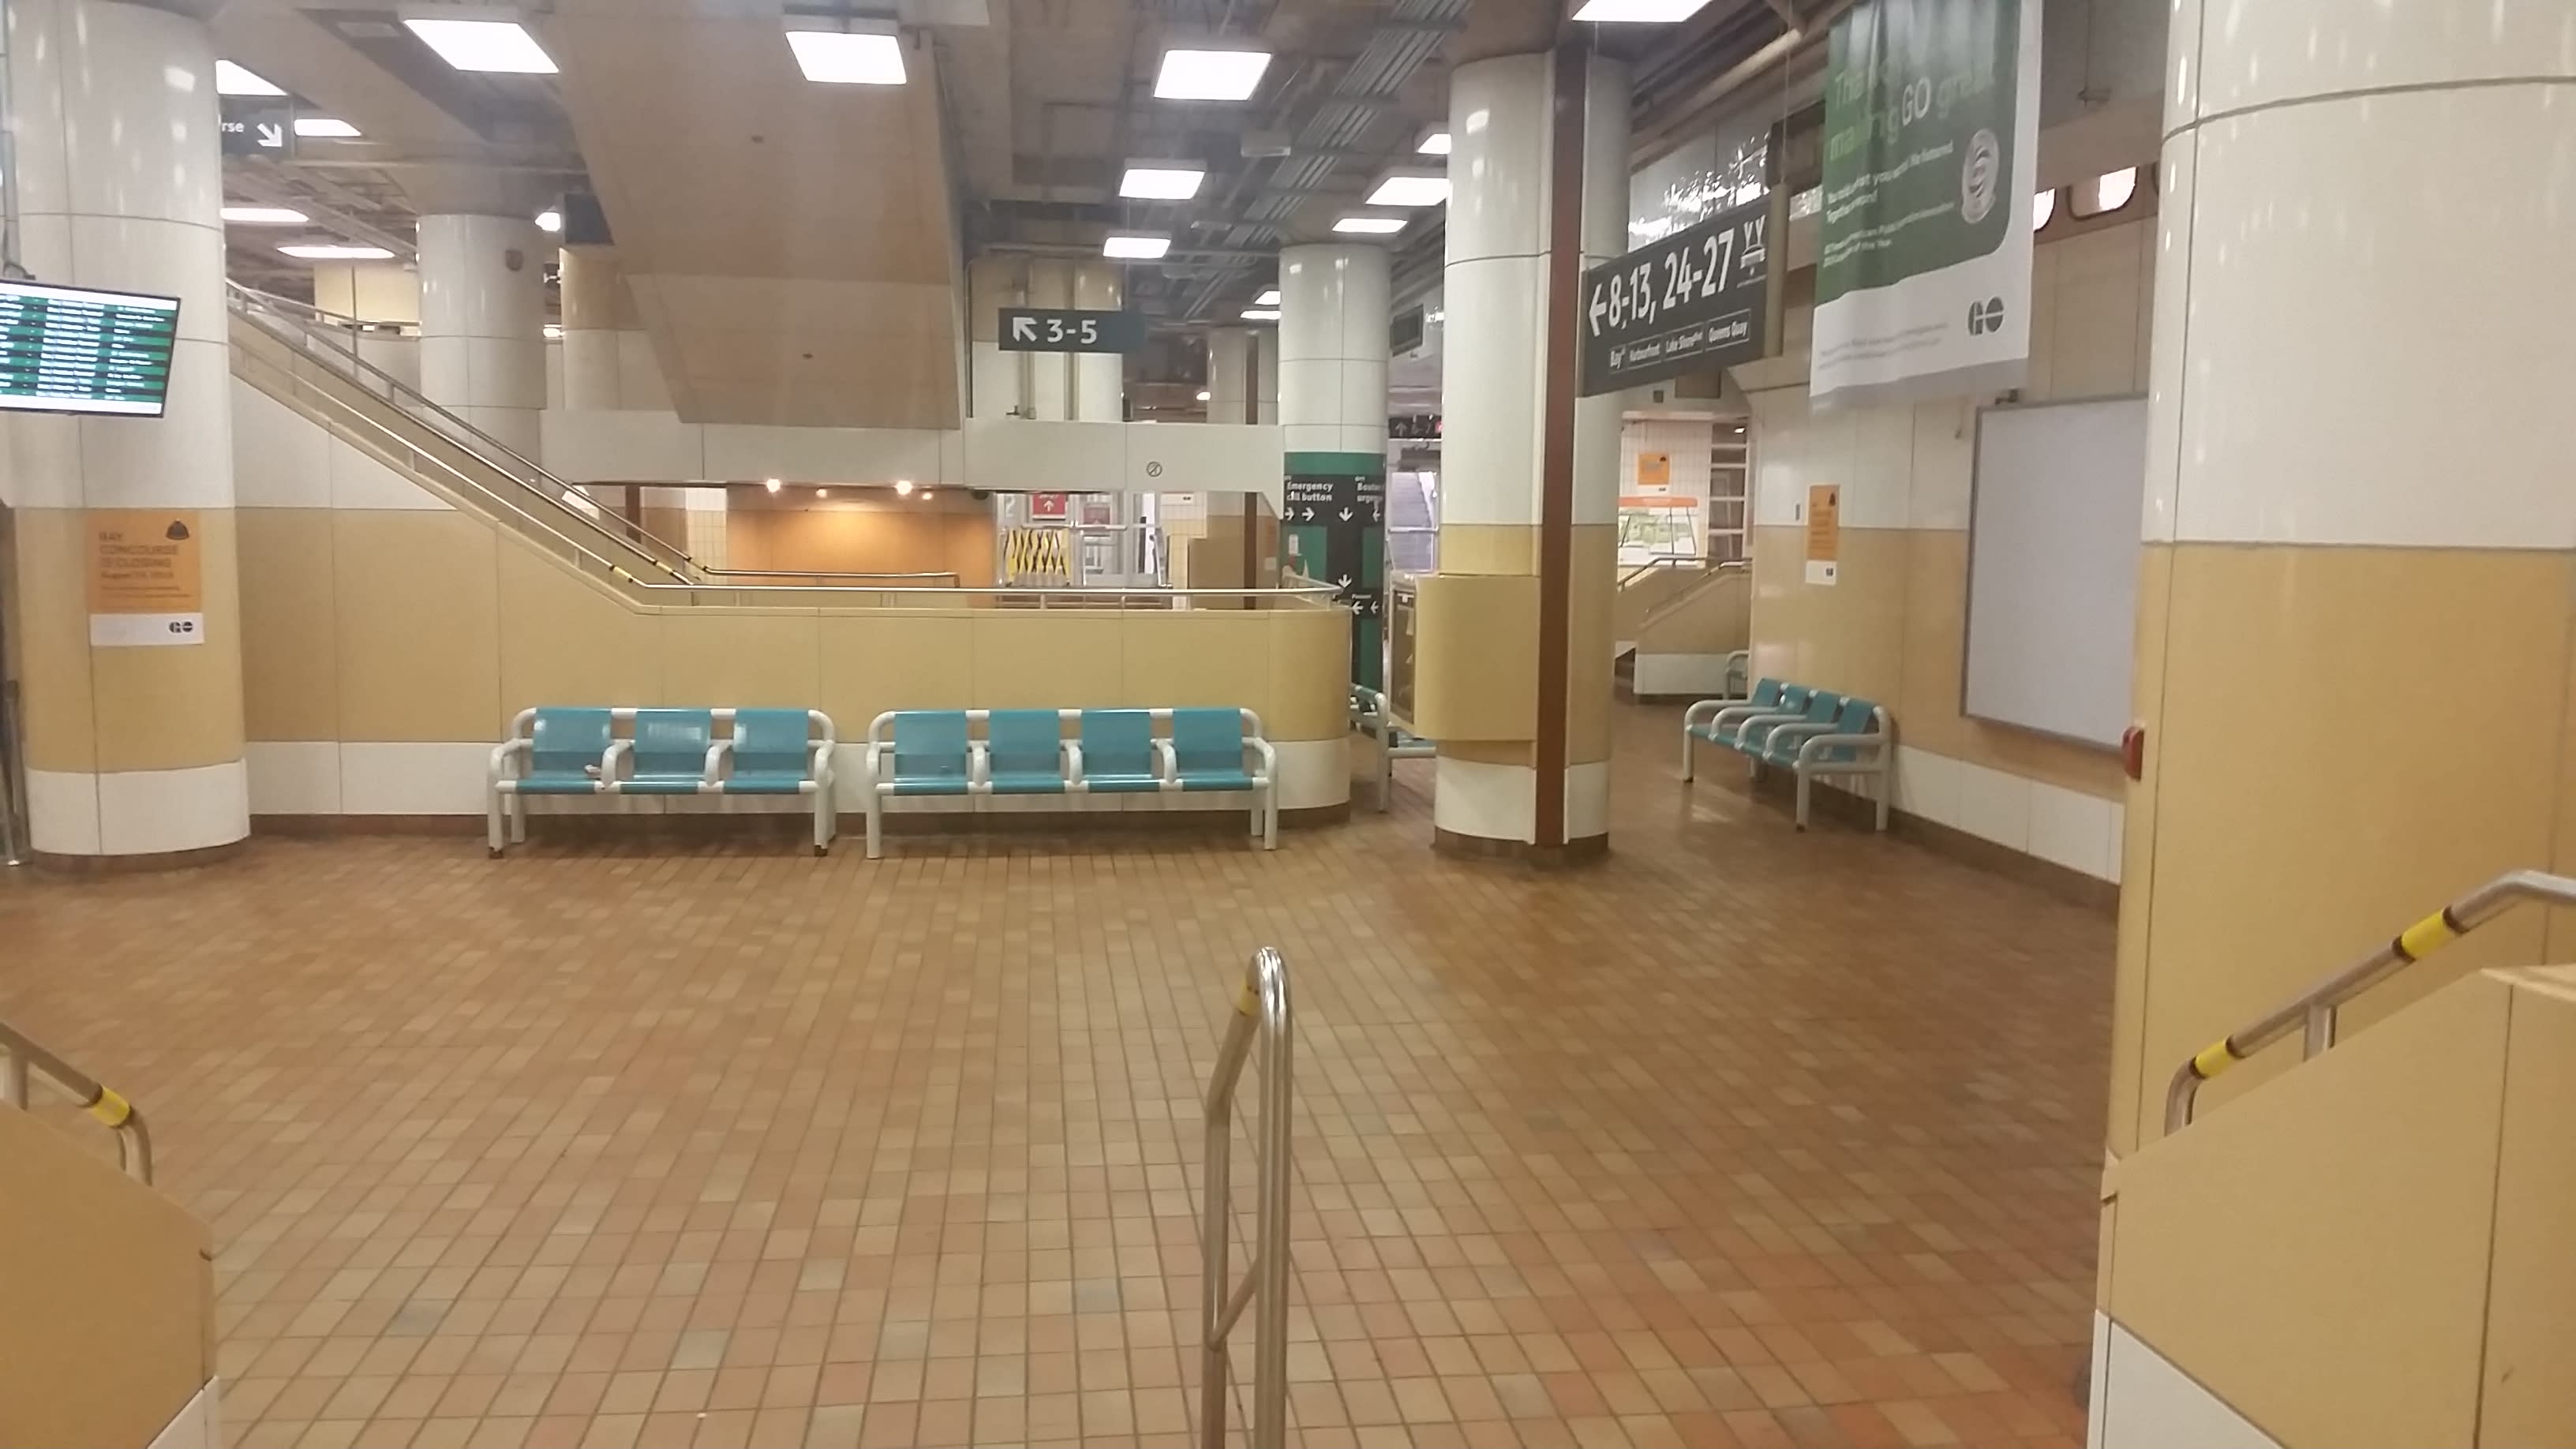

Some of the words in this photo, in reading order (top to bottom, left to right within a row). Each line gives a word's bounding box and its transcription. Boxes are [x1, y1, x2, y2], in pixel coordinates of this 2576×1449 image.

[1901, 77, 1931, 126] GO
[1662, 227, 1735, 310] 24-27
[1046, 319, 1097, 344] 3-5
[1286, 481, 1334, 492] Emergency
[1301, 492, 1333, 502] button
